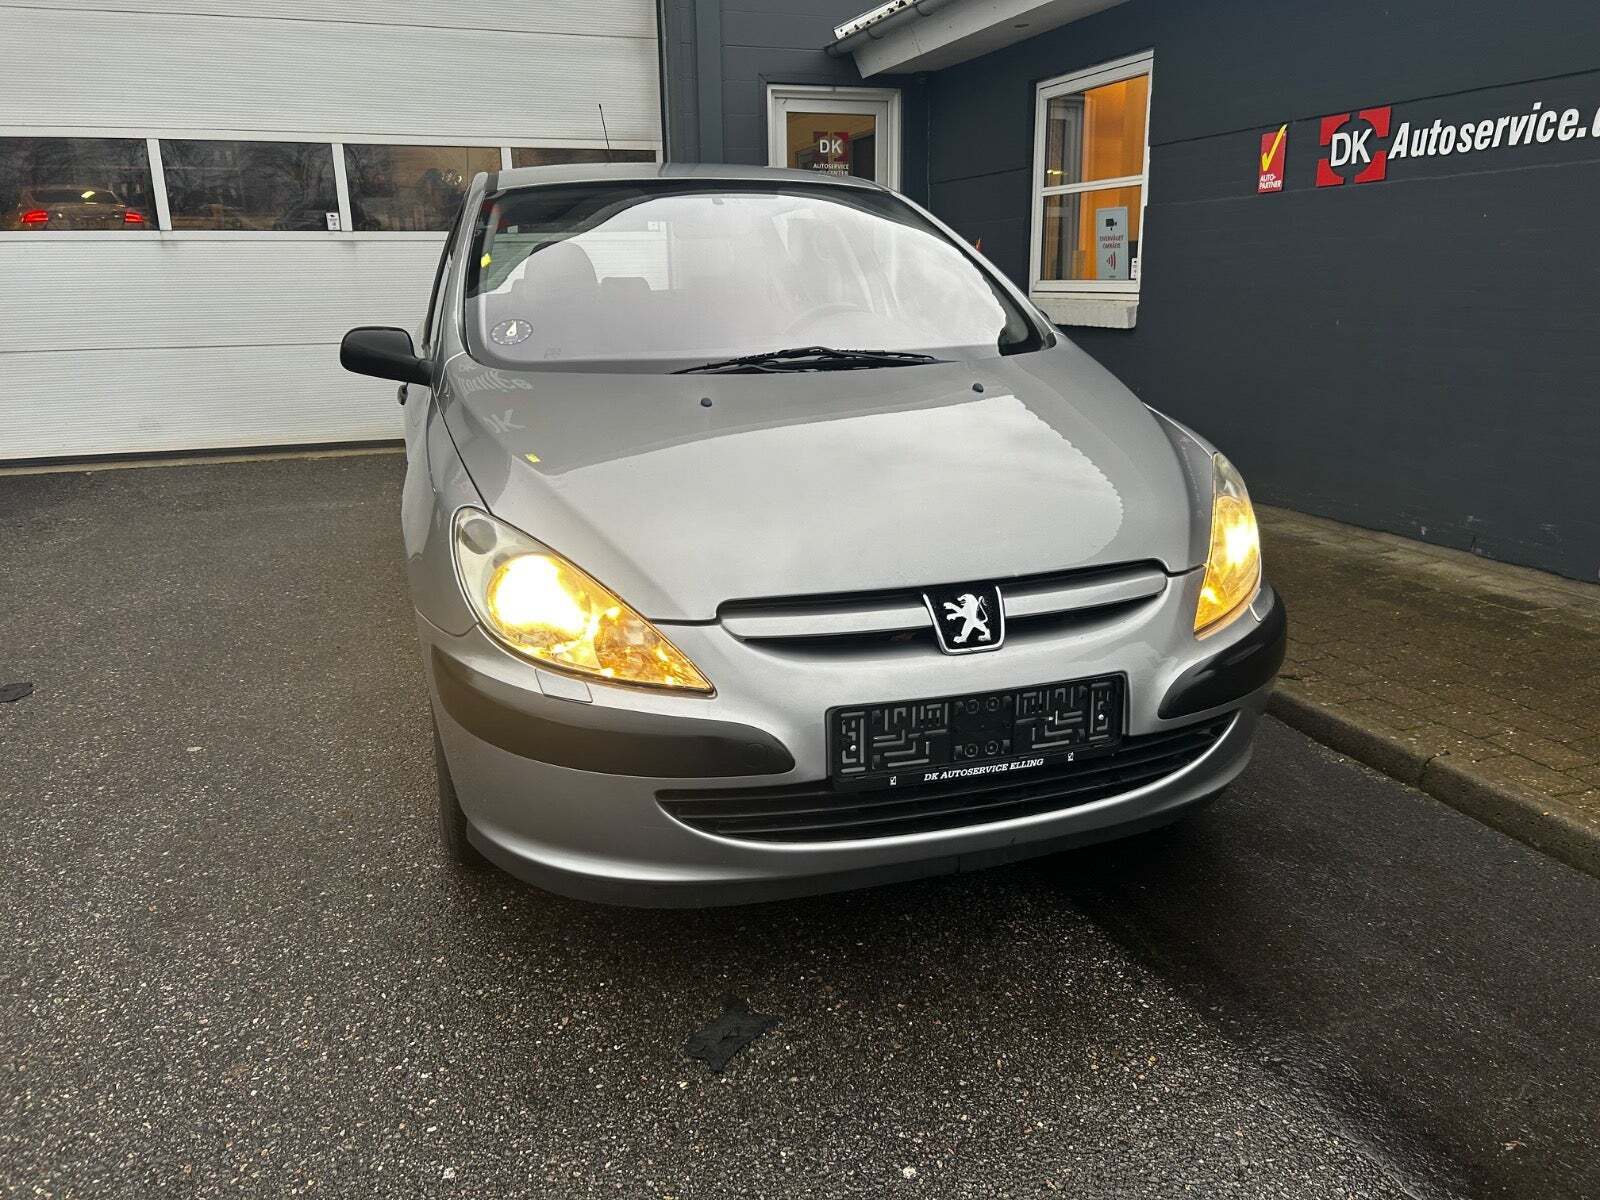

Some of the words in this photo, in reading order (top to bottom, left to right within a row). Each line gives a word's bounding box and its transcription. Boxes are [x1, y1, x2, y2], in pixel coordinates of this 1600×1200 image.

[819, 139, 843, 154] DK
[1330, 128, 1374, 167] DK
[923, 772, 940, 781] DK
[940, 763, 1009, 780] AUTOSERVICE
[1009, 758, 1044, 770] ELLING
